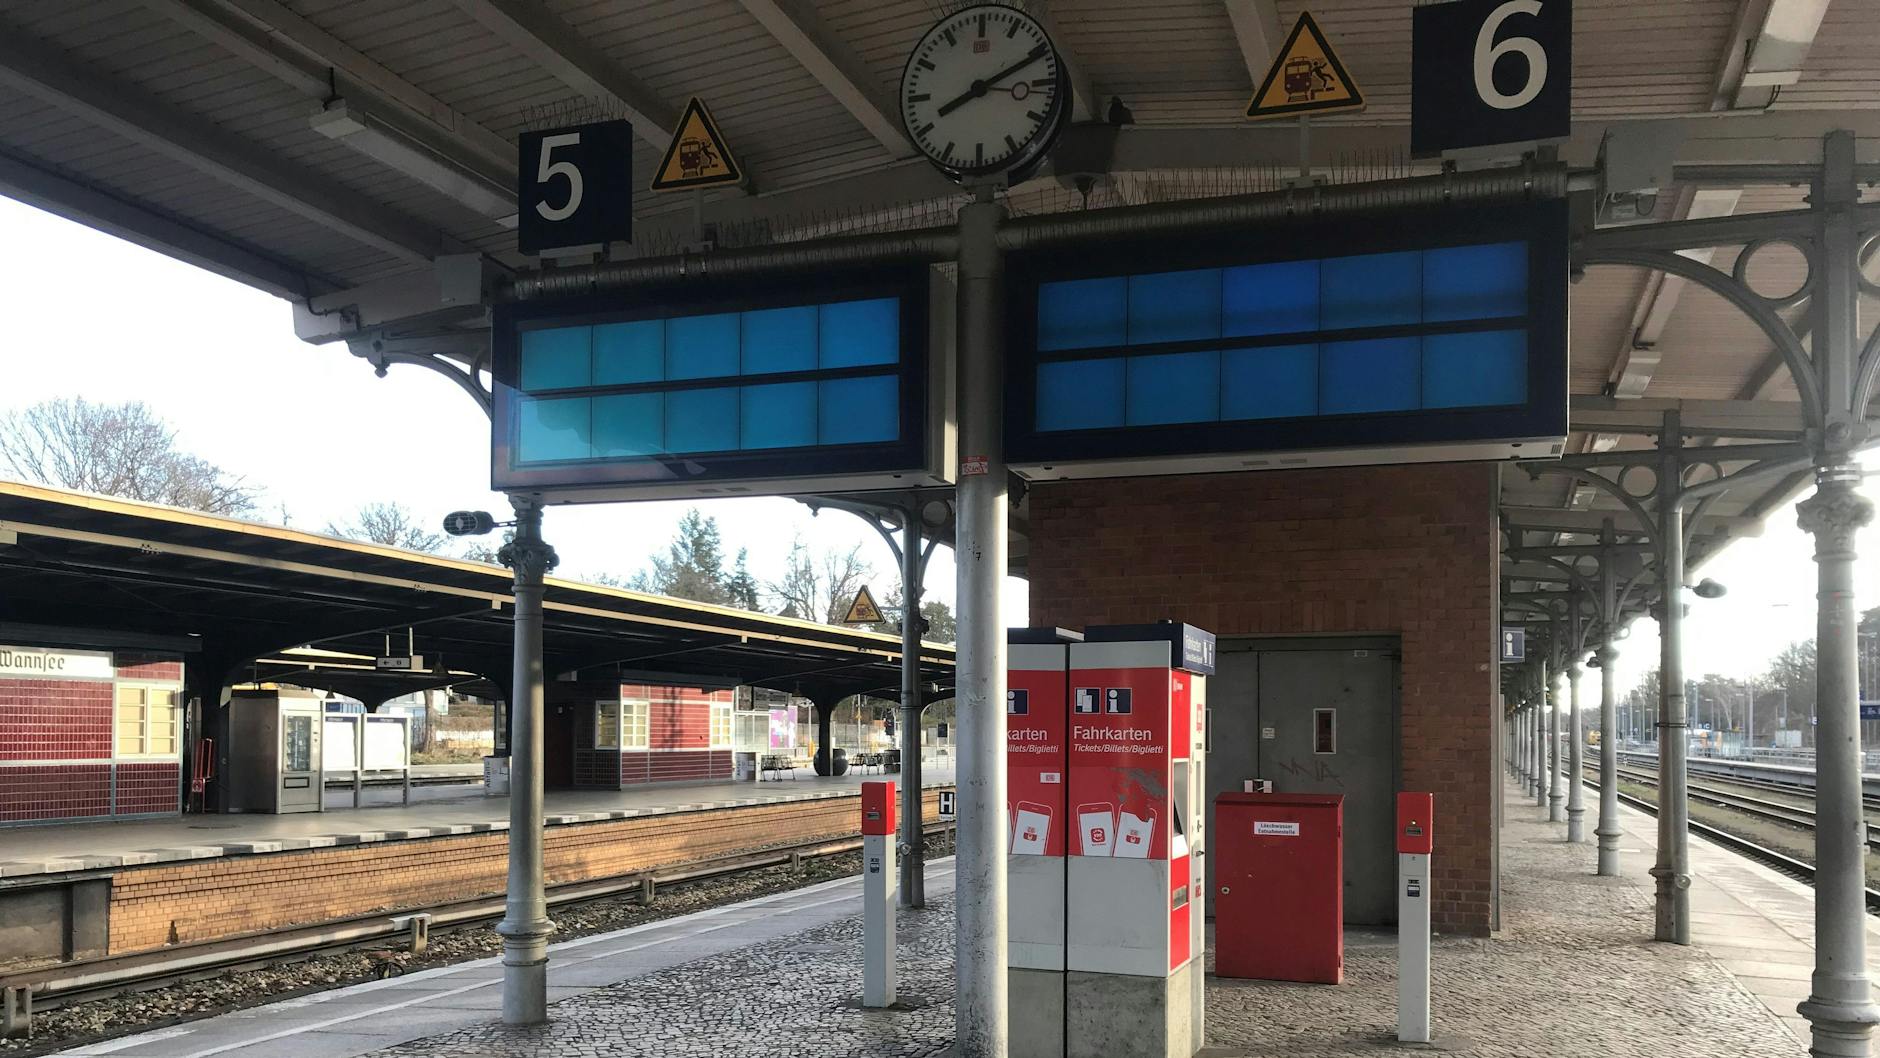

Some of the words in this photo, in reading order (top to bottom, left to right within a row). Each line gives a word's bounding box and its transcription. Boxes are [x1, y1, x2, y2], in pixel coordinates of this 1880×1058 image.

[1474, 0, 1548, 109] 6
[536, 132, 584, 222] 5
[1073, 726, 1152, 741] Fahrkarten
[940, 793, 953, 813] H
